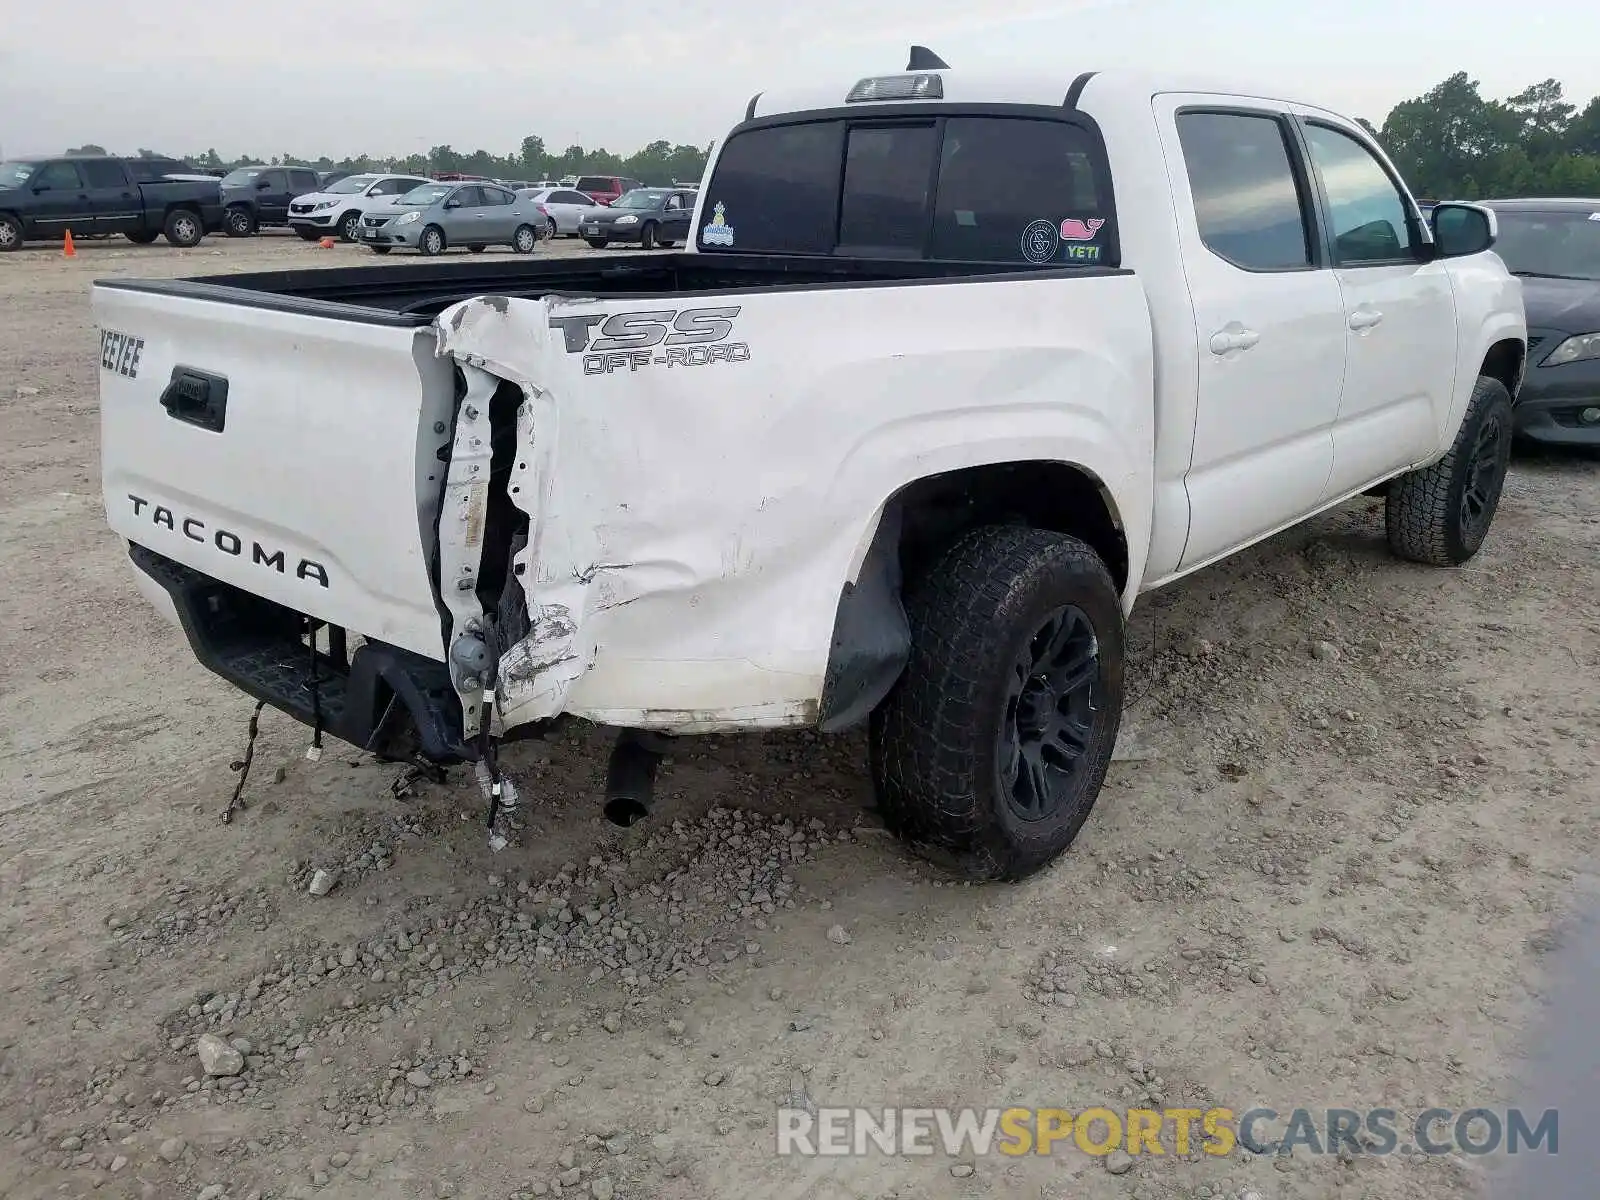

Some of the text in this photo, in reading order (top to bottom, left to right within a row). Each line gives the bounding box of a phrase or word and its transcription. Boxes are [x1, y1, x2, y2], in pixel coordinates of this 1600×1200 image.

[1067, 245, 1101, 259] YETI
[549, 306, 742, 353] TSS
[101, 328, 144, 379] YEEYEE
[583, 342, 751, 375] OFF-ROAD
[128, 494, 329, 588] TACOMA
